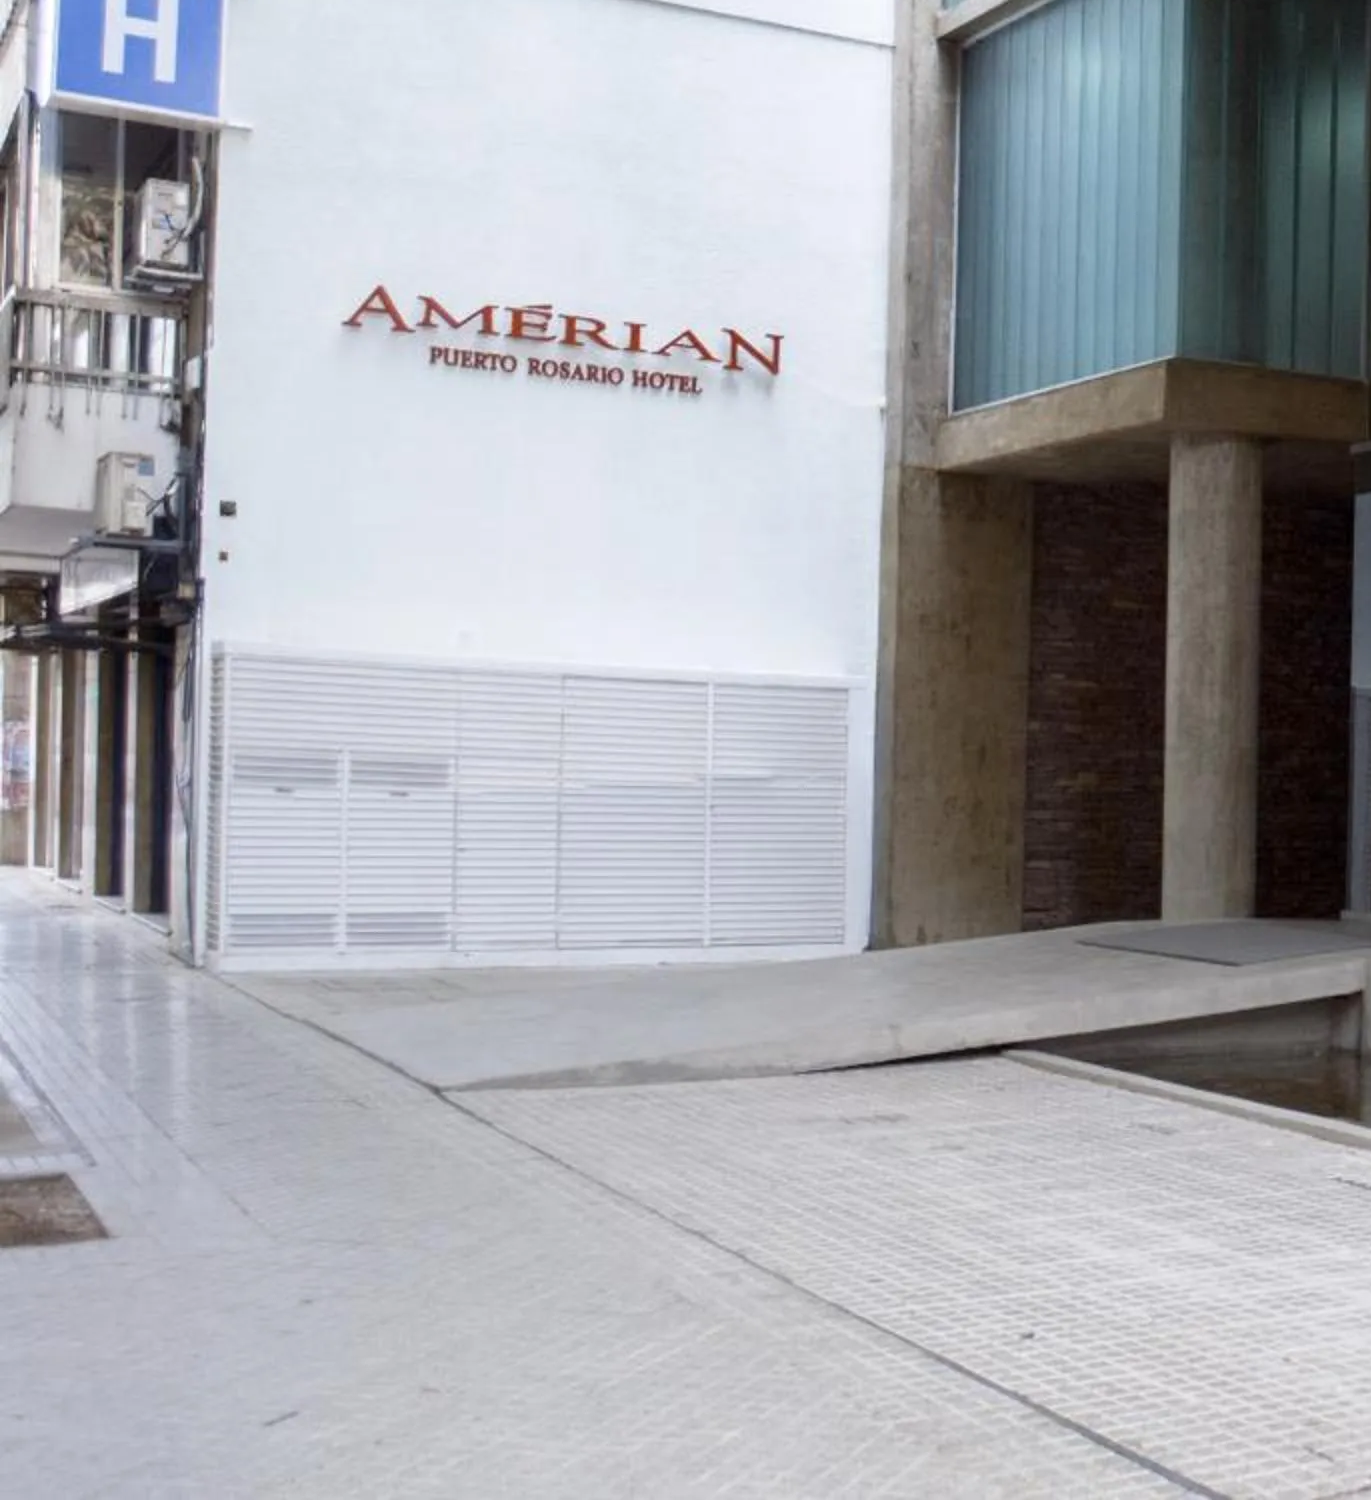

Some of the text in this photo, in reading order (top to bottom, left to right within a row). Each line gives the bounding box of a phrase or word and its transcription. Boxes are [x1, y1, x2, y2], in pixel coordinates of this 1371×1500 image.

[341, 284, 784, 376] AMÉRIAN
[428, 346, 704, 394] PUERTO ROSARIO HOTEL
